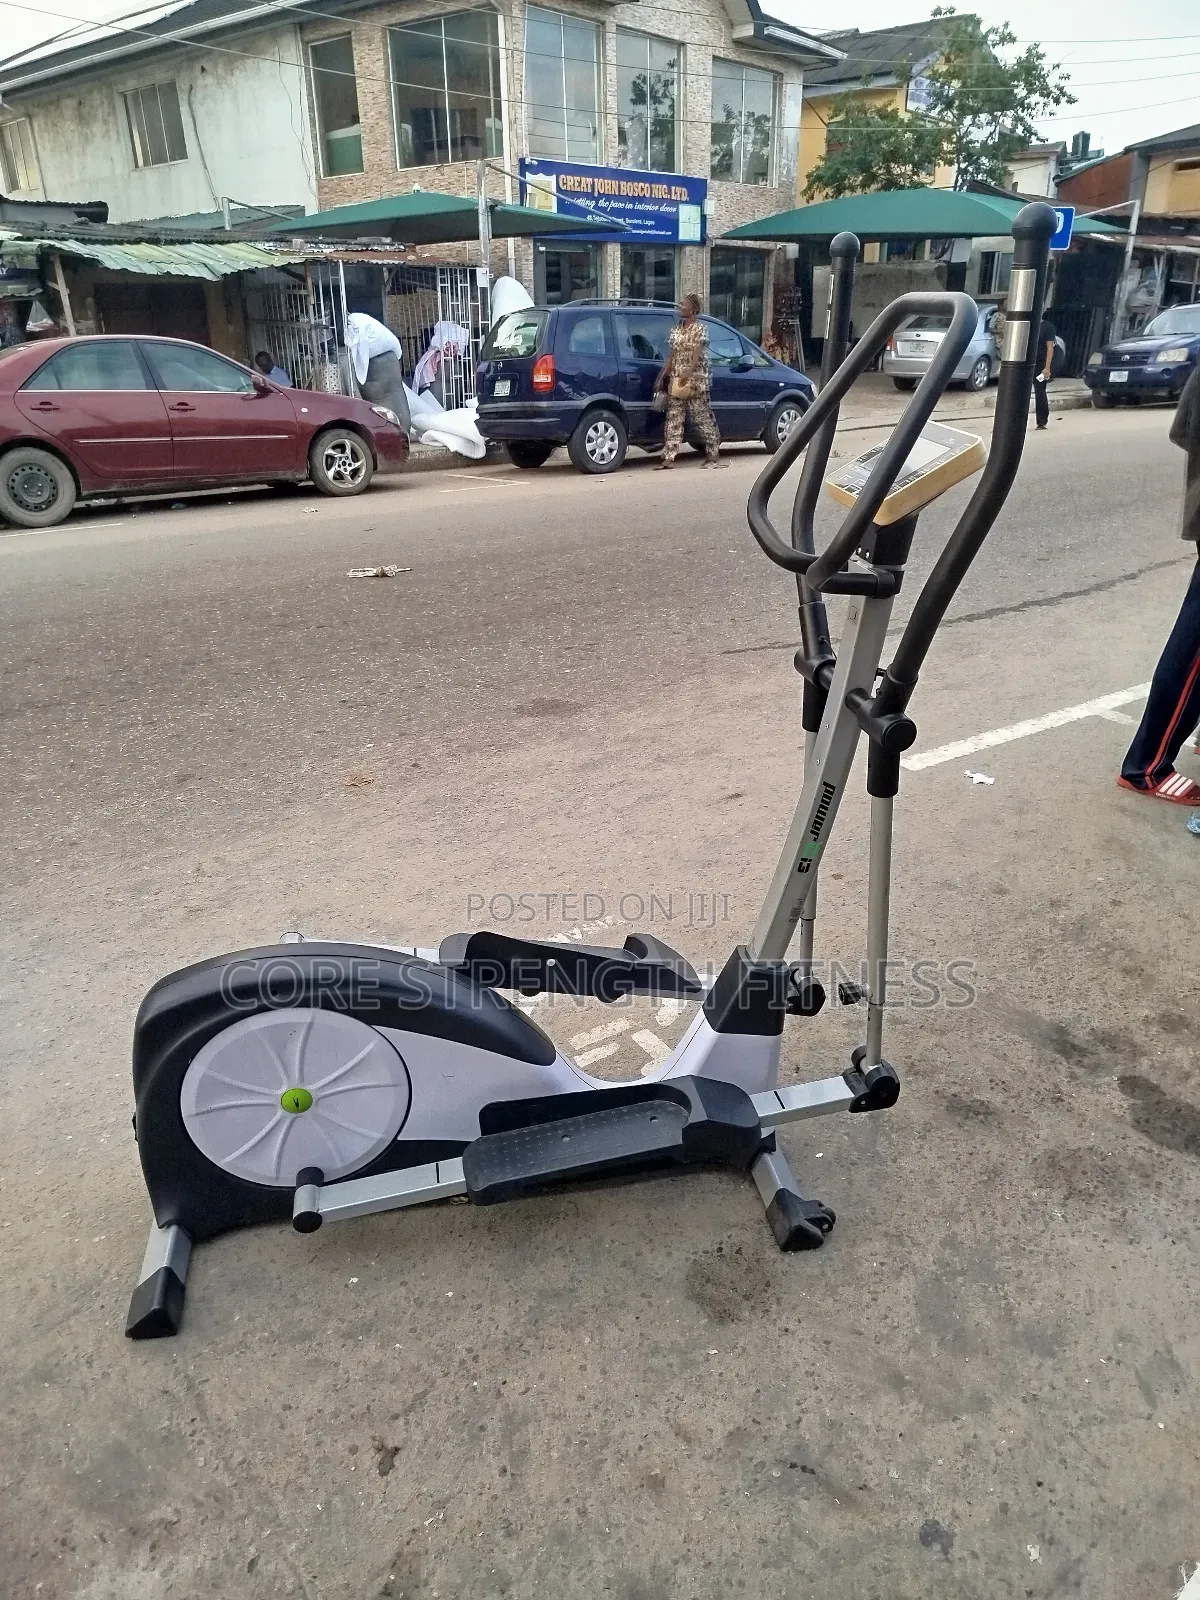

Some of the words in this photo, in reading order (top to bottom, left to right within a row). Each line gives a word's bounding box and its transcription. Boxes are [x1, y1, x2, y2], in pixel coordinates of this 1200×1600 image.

[559, 175, 592, 192] GREAT
[594, 179, 619, 197] JOHN
[619, 181, 651, 198] BOSCO
[671, 186, 689, 202] LTD.
[598, 198, 609, 207] the
[607, 199, 625, 211] pace
[634, 202, 659, 211] interior
[660, 203, 677, 212] decor
[809, 781, 836, 842] power
[797, 857, 813, 873] i3
